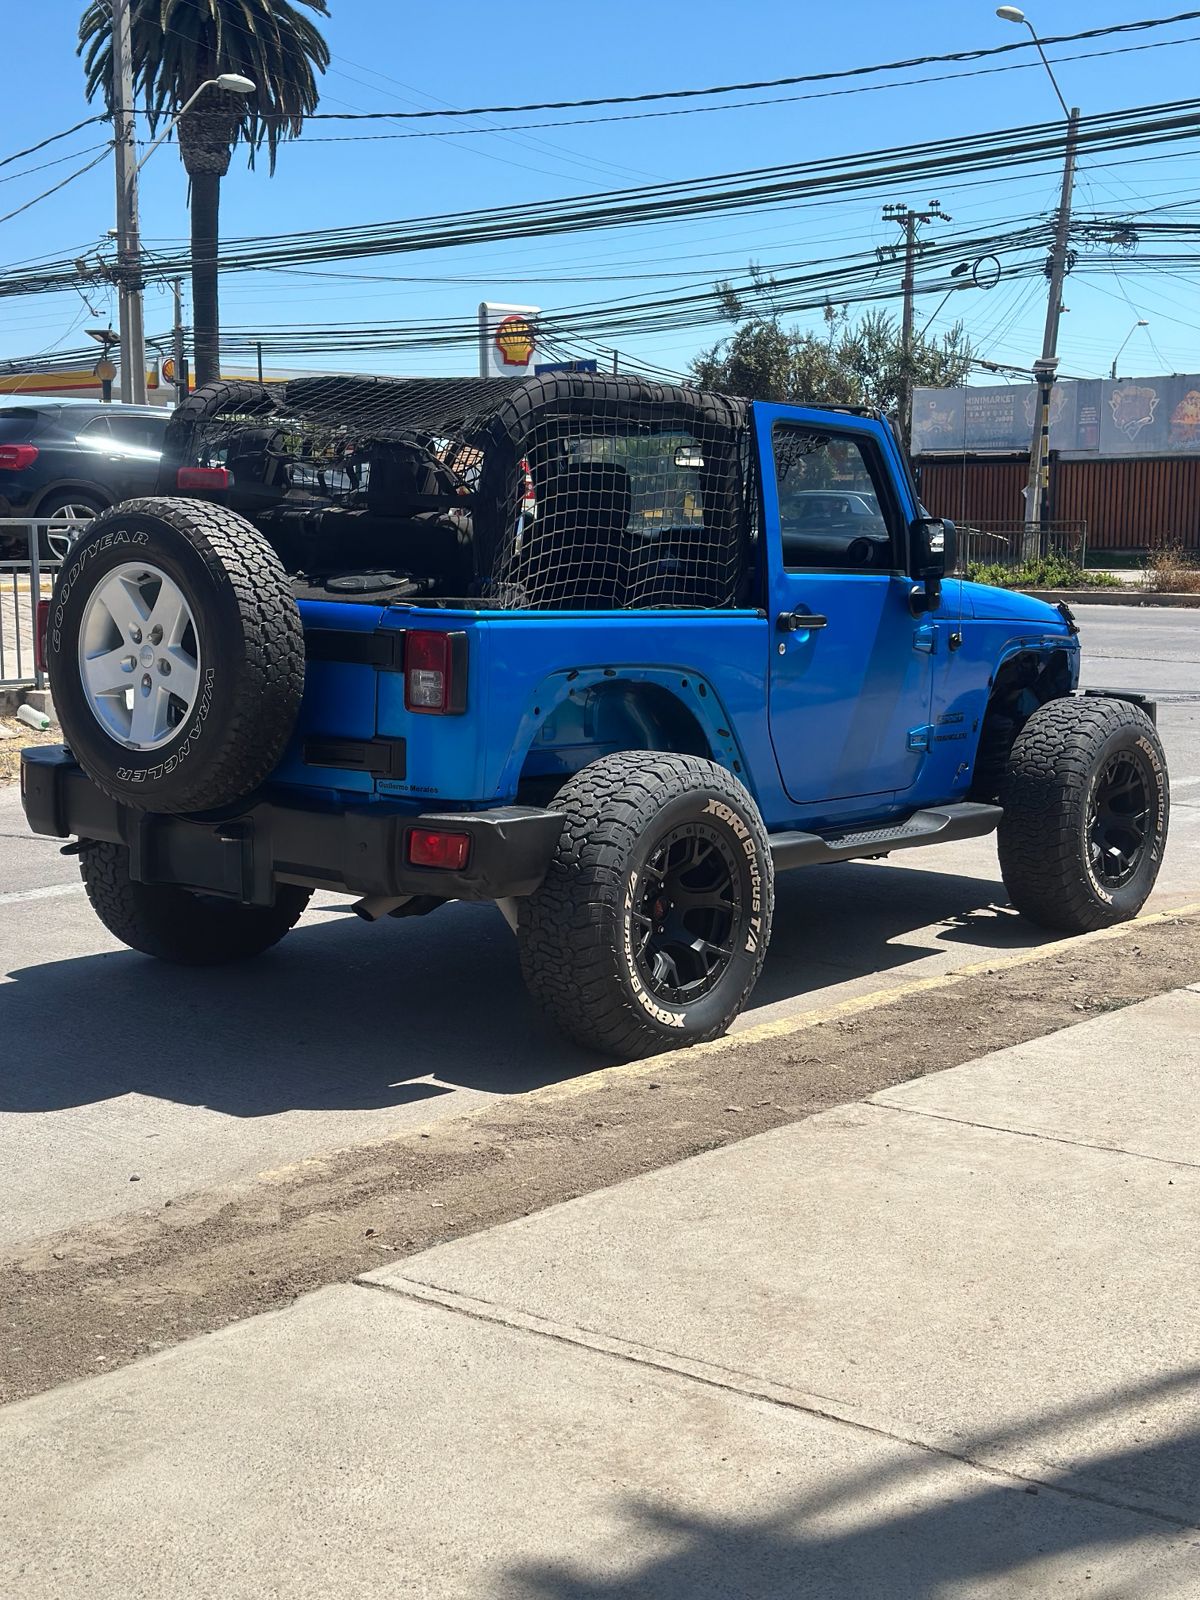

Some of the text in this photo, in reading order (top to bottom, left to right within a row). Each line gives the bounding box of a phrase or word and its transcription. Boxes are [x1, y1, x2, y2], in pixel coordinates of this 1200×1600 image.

[966, 394, 1016, 405] MINIMARKET
[53, 530, 151, 653] GOODYEAR
[116, 667, 215, 783] WRANGLER
[1135, 735, 1162, 773] XBRI
[409, 785, 439, 794] Morales
[702, 799, 762, 953] XBRI Brutus T/A
[637, 988, 687, 1028] XBRI
